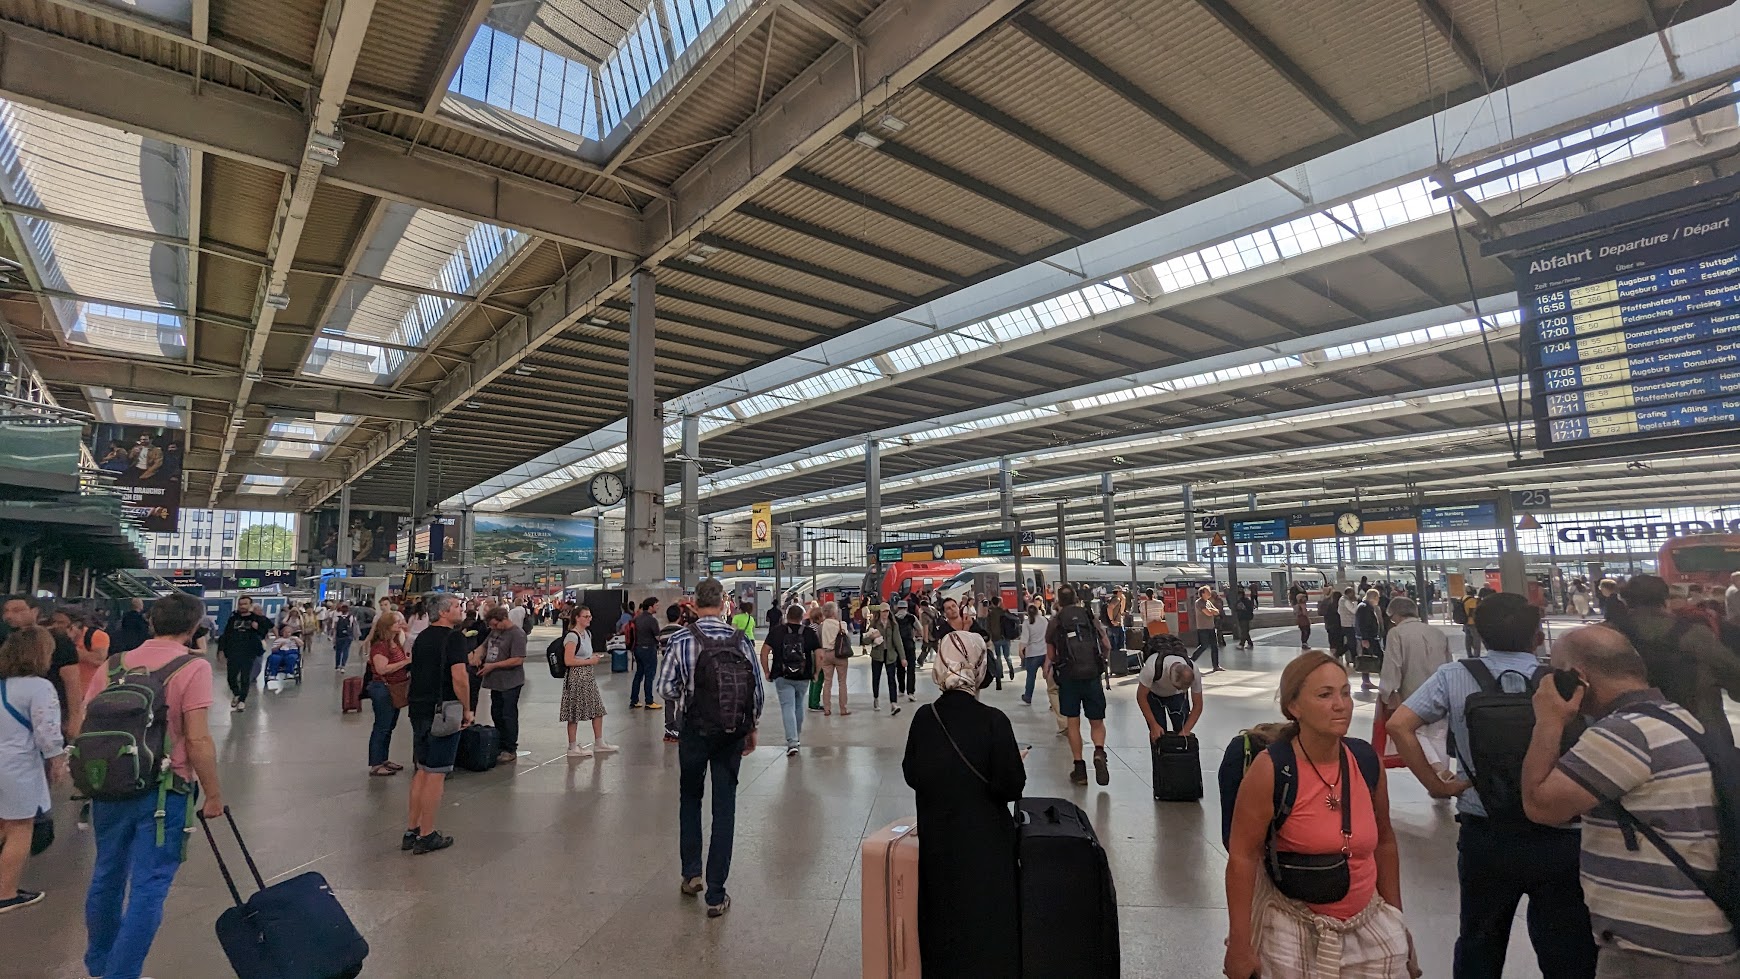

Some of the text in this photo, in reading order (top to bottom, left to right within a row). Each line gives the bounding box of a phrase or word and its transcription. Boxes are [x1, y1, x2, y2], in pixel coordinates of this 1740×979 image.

[1529, 217, 1730, 274] Abfahrt Departure / Départ
[1616, 262, 1634, 271] Über
[1536, 292, 1564, 304] 16:45
[1585, 286, 1600, 294] 592
[1618, 274, 1656, 287] Augsburg
[1669, 268, 1685, 276] Ulm
[1699, 254, 1738, 269] Stuttgart
[1538, 302, 1566, 314] 16:58
[1620, 284, 1658, 298] Augsburg
[1539, 317, 1567, 329] 17:00
[1541, 327, 1569, 339] 17:00
[1686, 300, 1721, 310] Freising
[1544, 342, 1571, 354] 17:04
[1626, 322, 1696, 339] Donnersbergerbr.
[1546, 368, 1574, 378] 17:06
[1630, 356, 1654, 365] Markt
[1658, 350, 1701, 360] Schwaben
[1548, 378, 1576, 389] 17:09
[1632, 365, 1670, 376] Augsburg
[1684, 354, 1736, 368] Donauwörth
[1549, 393, 1578, 404] 17:09
[1552, 403, 1579, 414] 17:11
[1553, 419, 1581, 429] 17:11
[1637, 411, 1667, 419] Grafing
[1680, 405, 1708, 414] Aßling
[1554, 429, 1582, 440] 17:17
[1639, 420, 1680, 430] Ingolstadt
[1694, 413, 1735, 423] Nürnberg
[134, 487, 165, 495] BRAUCHST
[1522, 490, 1546, 506] 25
[1203, 516, 1218, 528] 24
[1023, 532, 1032, 541] 23
[867, 544, 873, 552] 22
